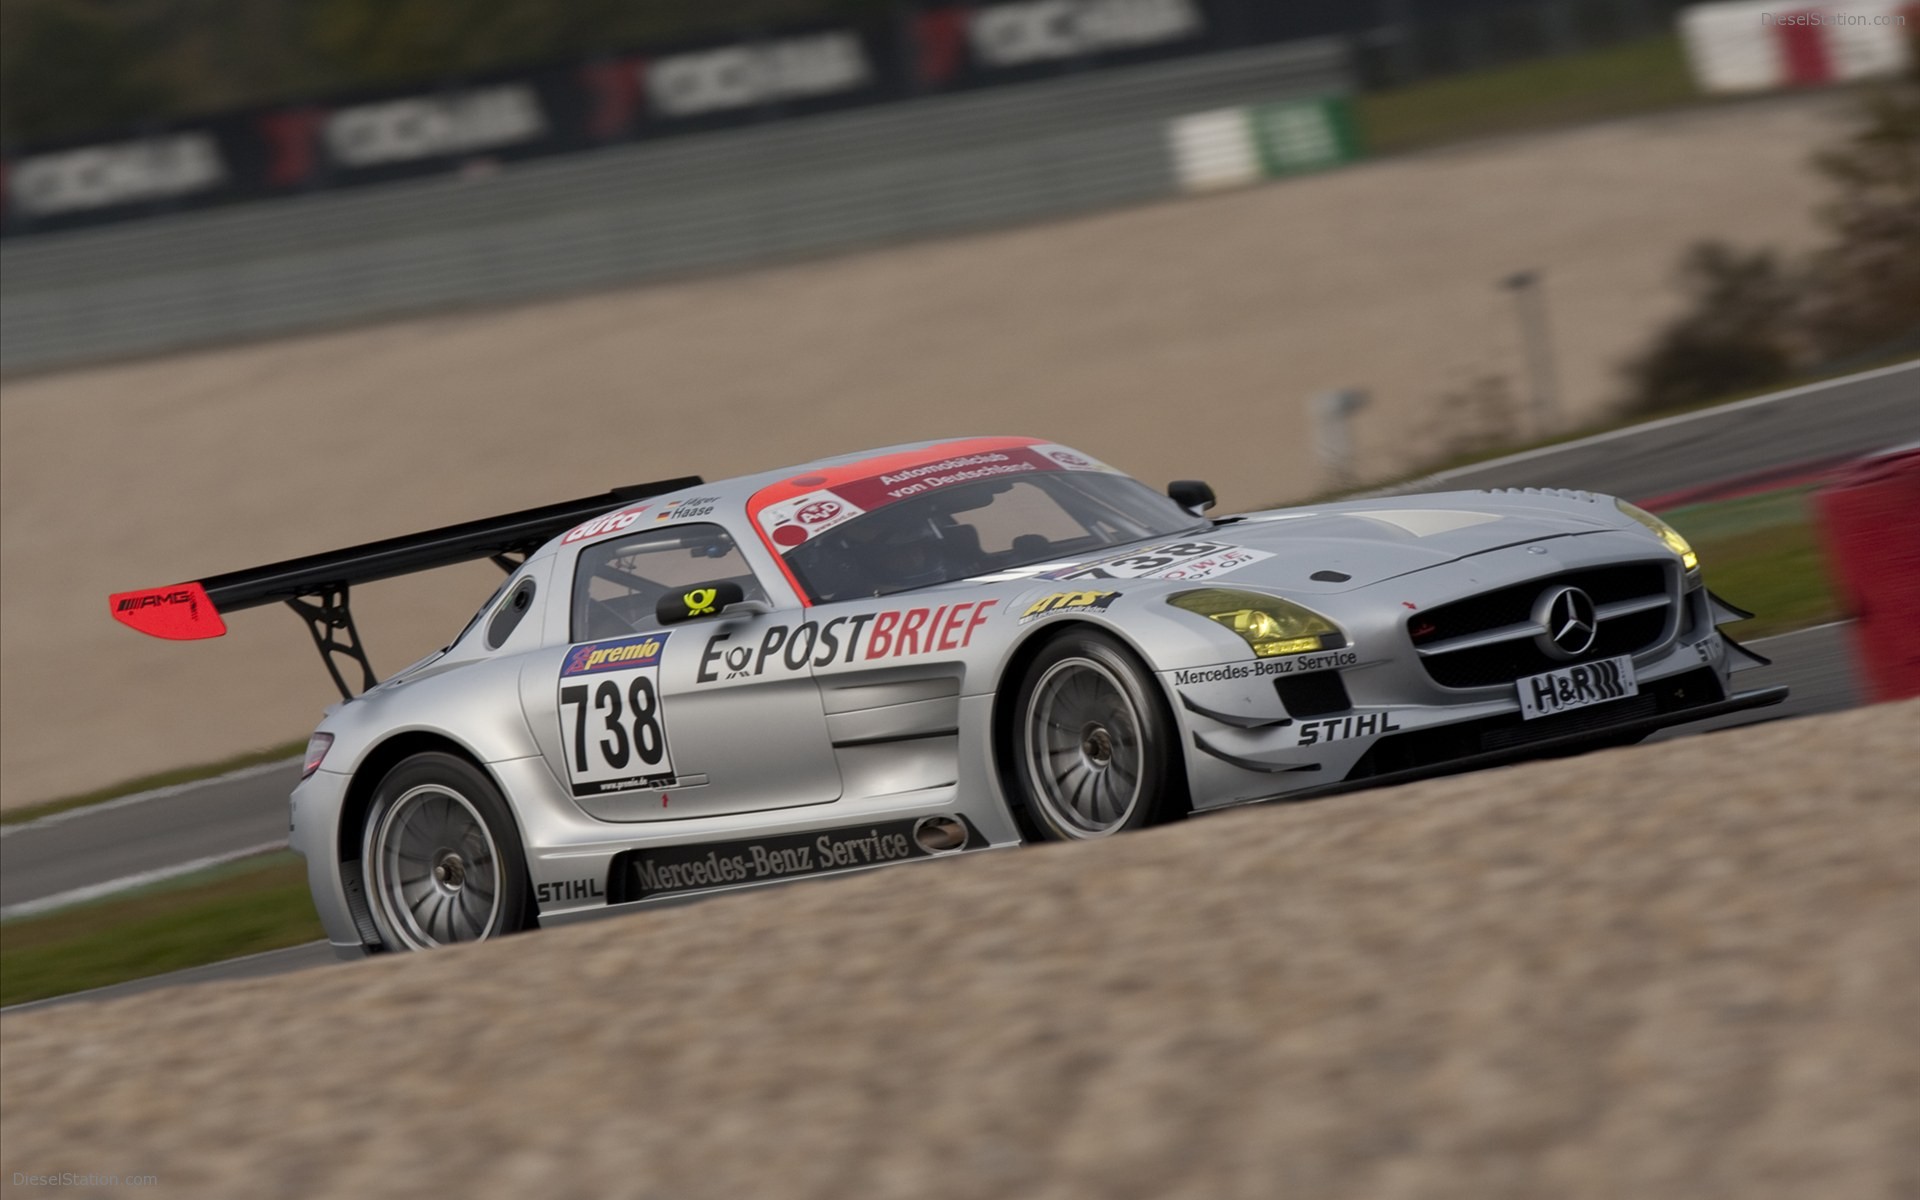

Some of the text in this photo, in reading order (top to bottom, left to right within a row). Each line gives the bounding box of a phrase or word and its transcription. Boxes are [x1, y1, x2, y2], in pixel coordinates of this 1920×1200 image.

[880, 453, 1009, 485] Automobilclub
[888, 461, 1036, 498] von Deutschland
[566, 511, 642, 543] auto
[671, 506, 714, 520] Haase
[801, 502, 840, 524] AvD
[1061, 543, 1218, 579] 738
[1023, 591, 1115, 616] ATS
[584, 638, 660, 671] premio
[1175, 651, 1357, 686] Mercedes-Benz Service
[1530, 667, 1597, 711] H&R
[561, 676, 663, 773] 738
[1298, 712, 1400, 747] STIHL
[633, 830, 909, 892] Mercedes-Benz Service
[538, 878, 604, 902] STIHL
